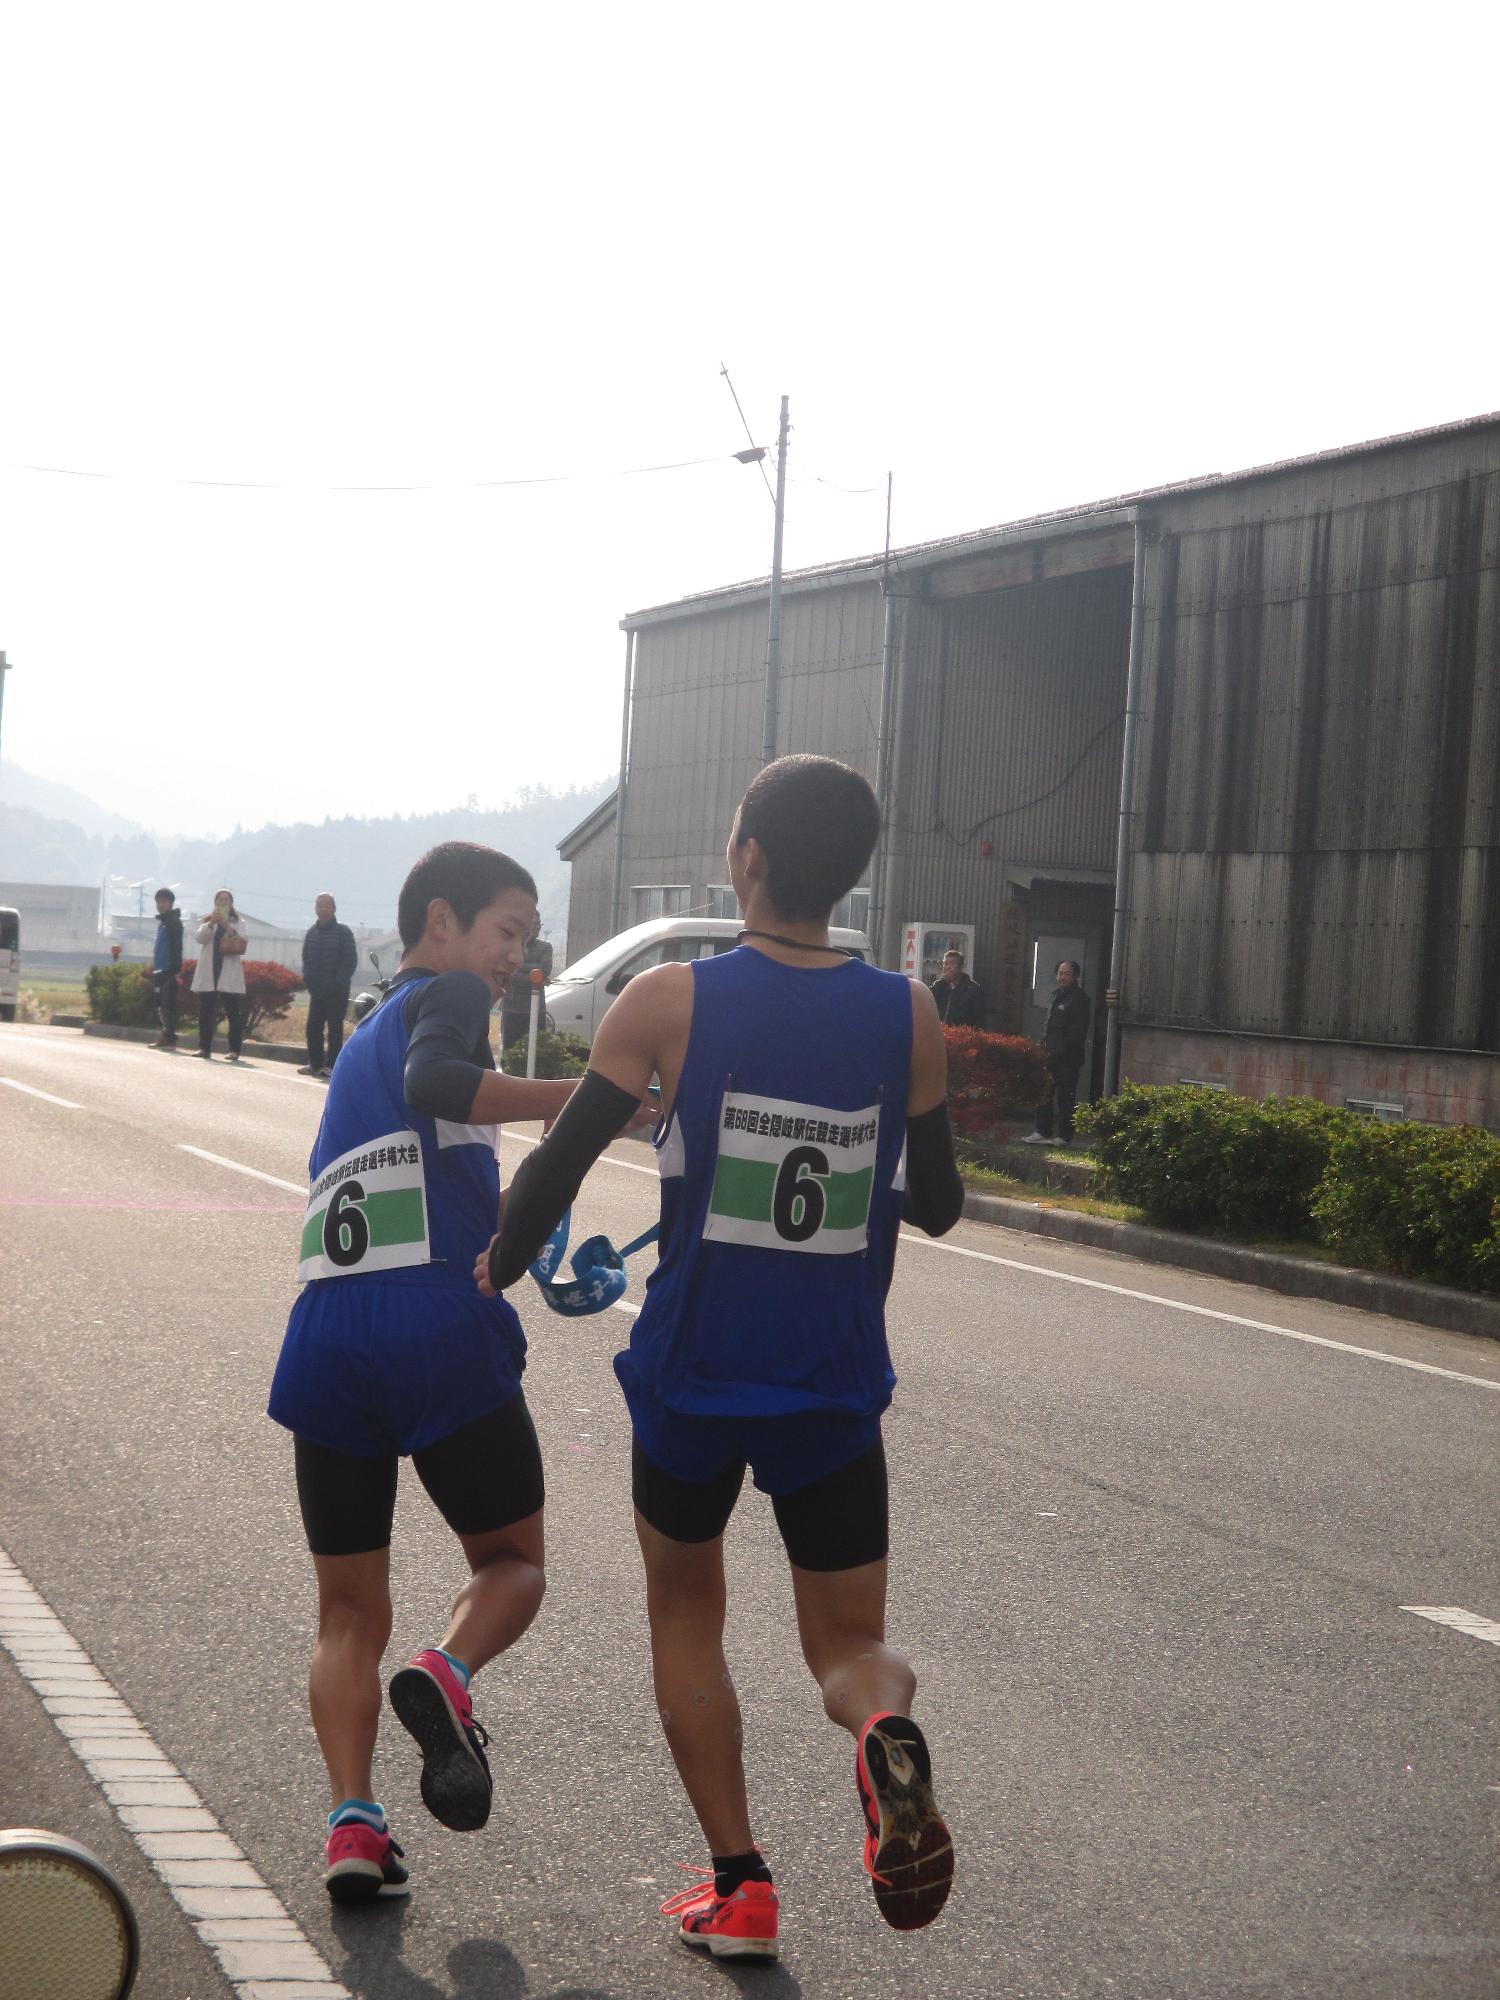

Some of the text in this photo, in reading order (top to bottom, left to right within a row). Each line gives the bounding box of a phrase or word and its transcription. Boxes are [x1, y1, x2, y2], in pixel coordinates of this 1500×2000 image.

[723, 1106, 876, 1149] 第68回全隠岐駅伝競走選手権大会
[323, 1179, 369, 1267] 6
[773, 1145, 830, 1243] 6
